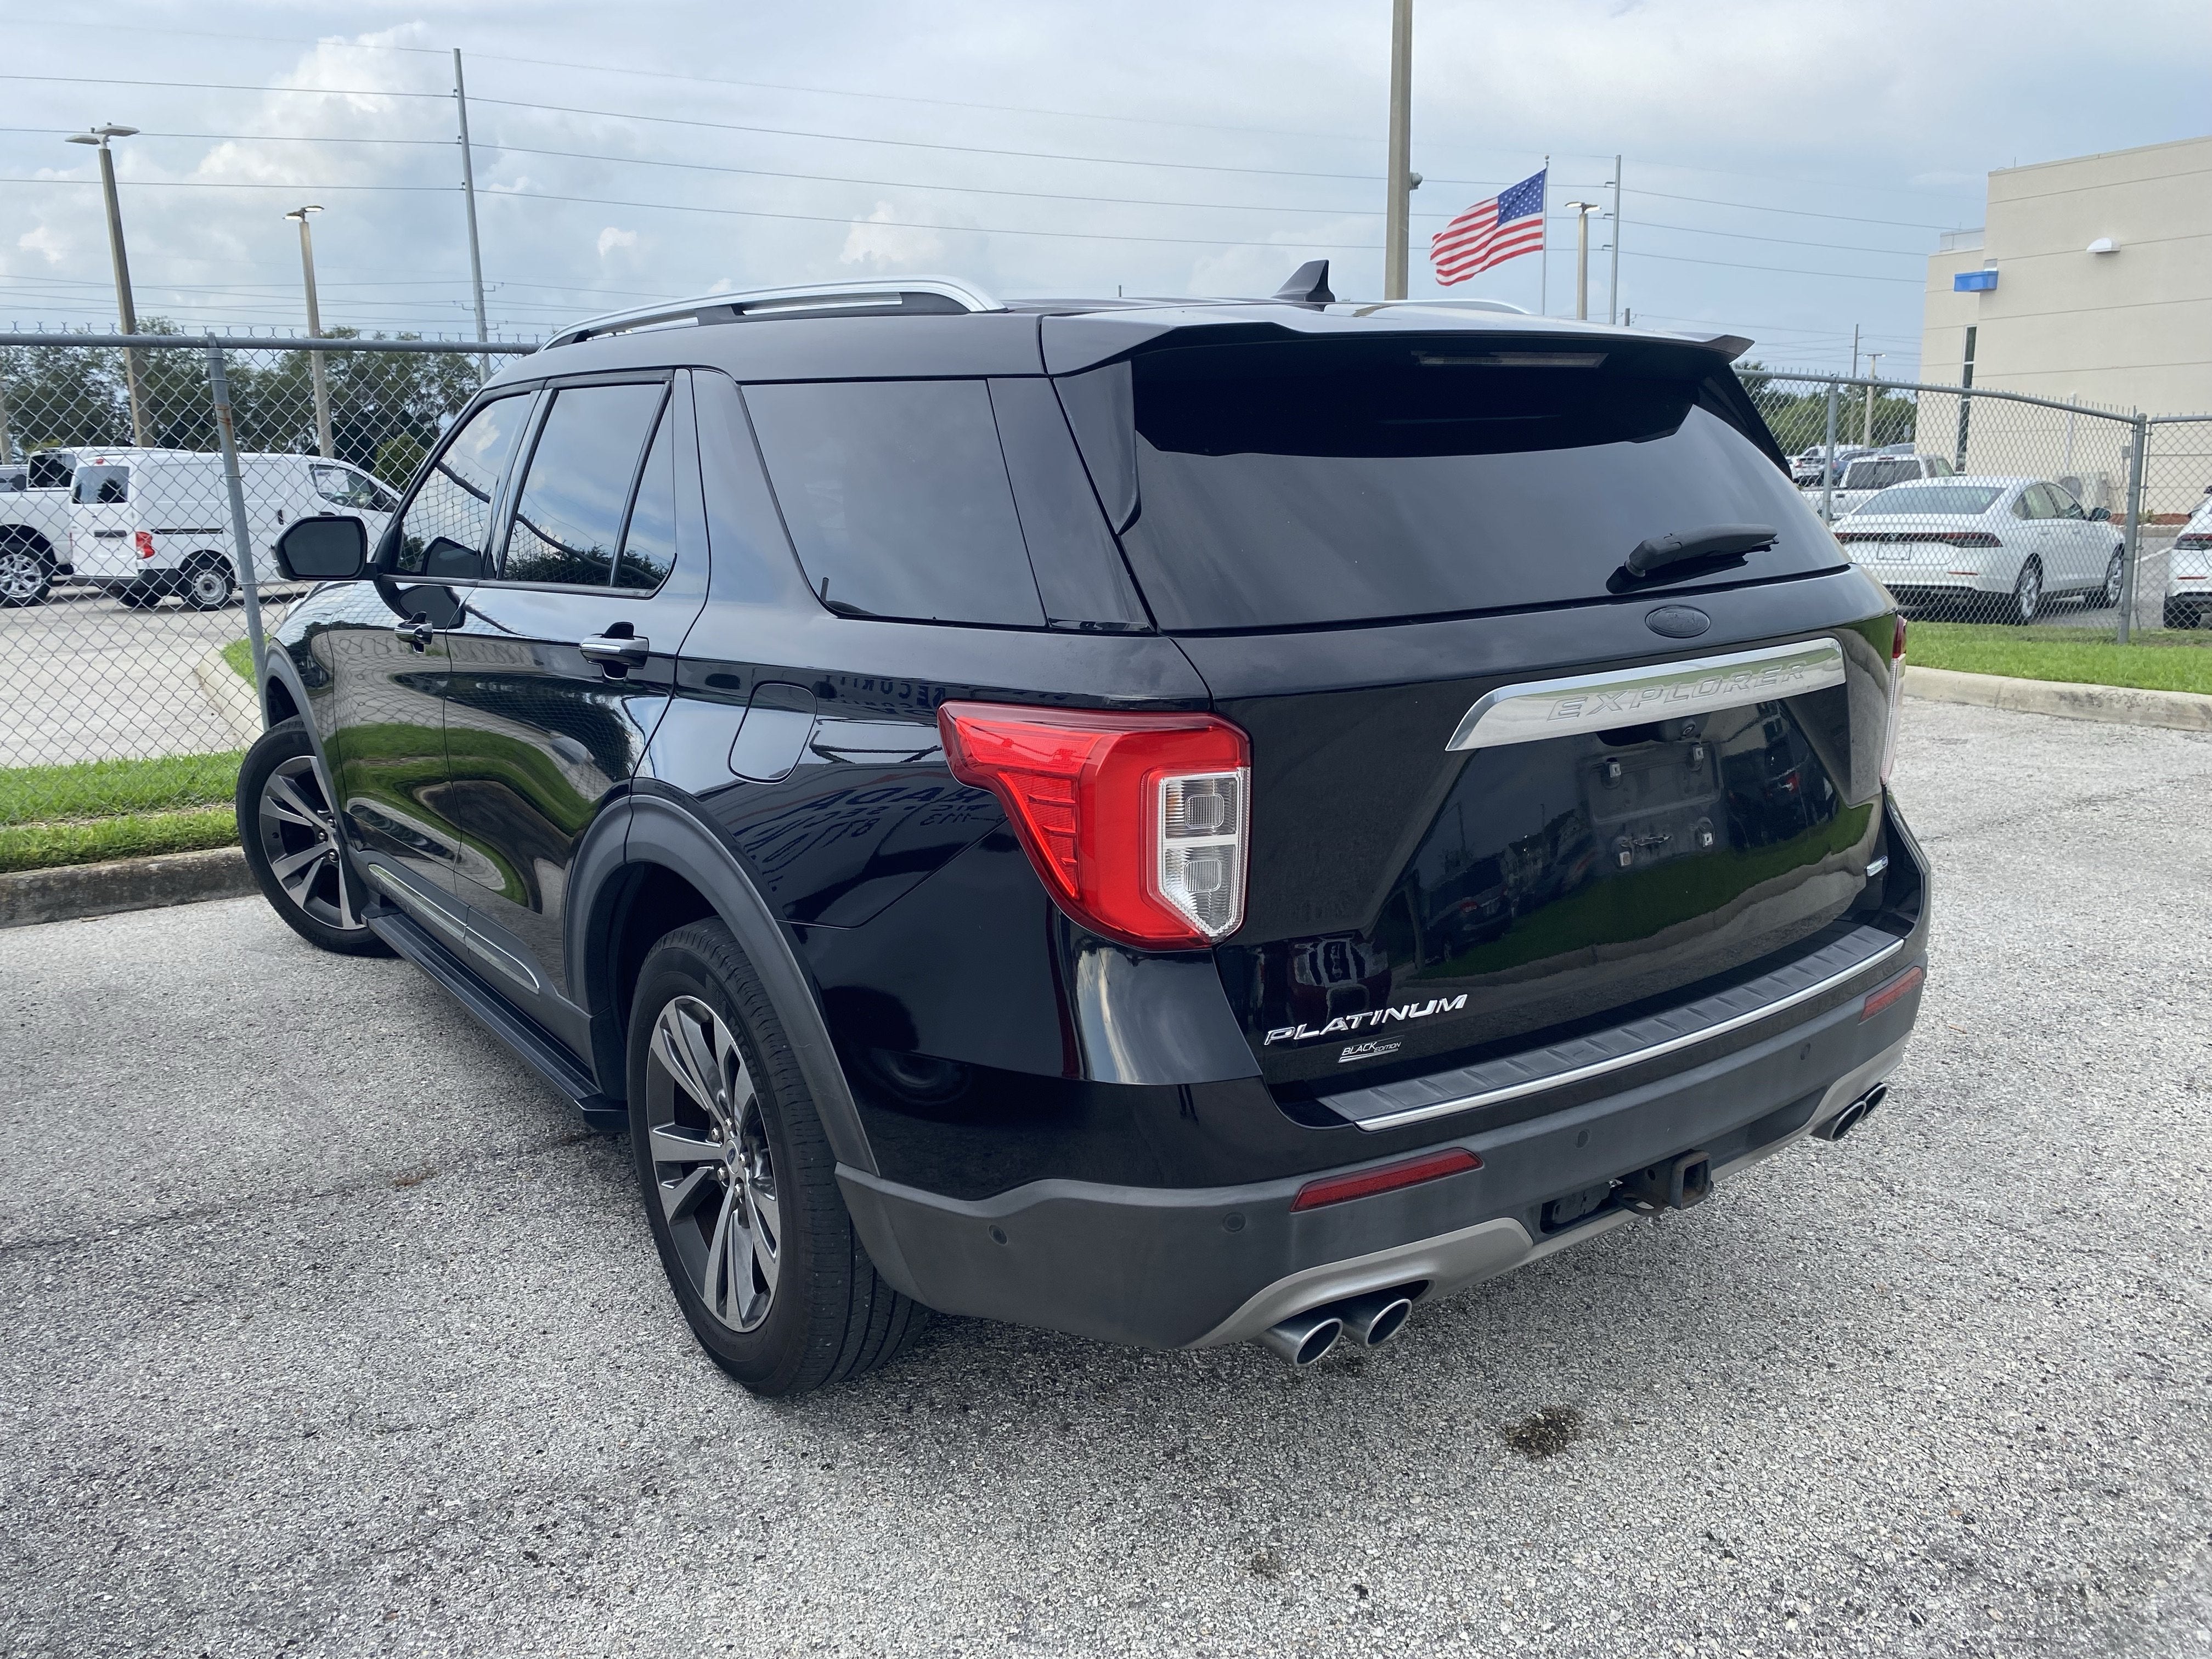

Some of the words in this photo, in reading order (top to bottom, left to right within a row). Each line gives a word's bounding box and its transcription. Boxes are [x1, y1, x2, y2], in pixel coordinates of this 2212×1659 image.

[1547, 660, 1807, 721] EXPLORER
[1263, 994, 1468, 1046] PLATINUM
[1341, 1041, 1378, 1056] BLACK
[1373, 1041, 1402, 1053] EDITION
